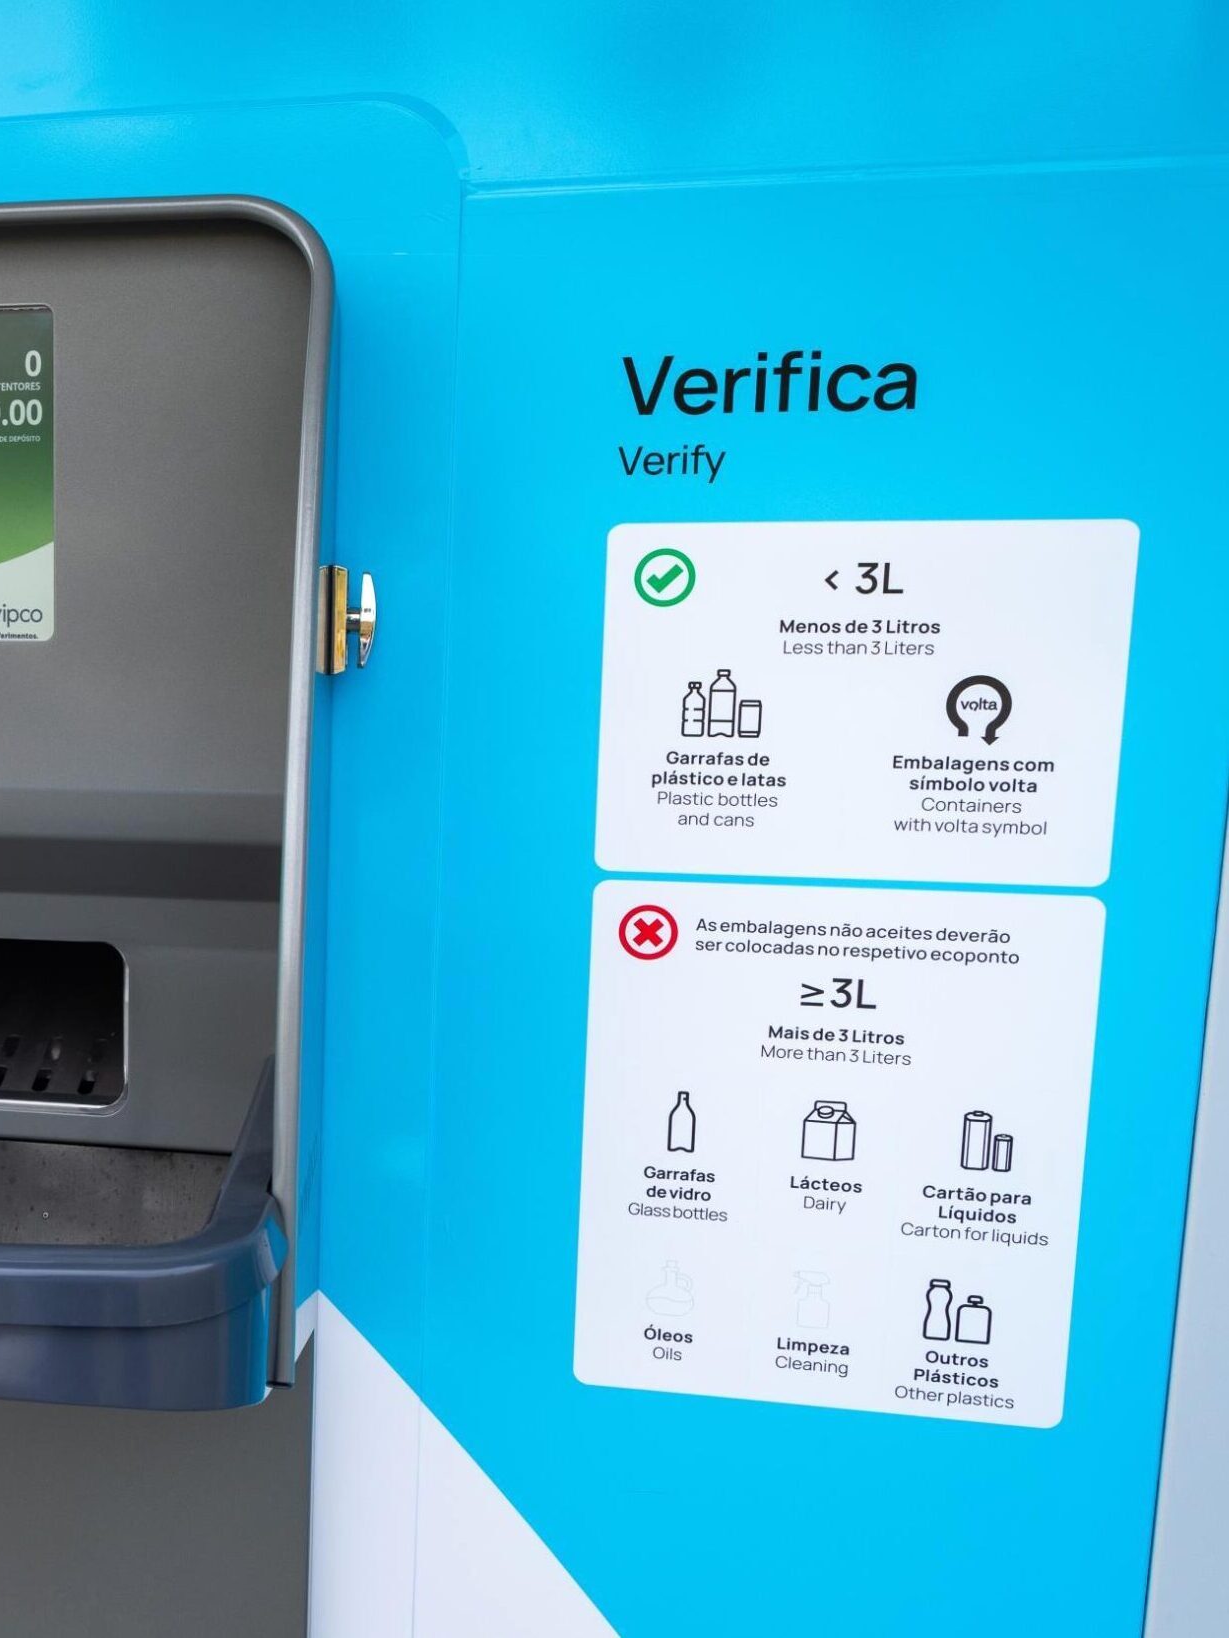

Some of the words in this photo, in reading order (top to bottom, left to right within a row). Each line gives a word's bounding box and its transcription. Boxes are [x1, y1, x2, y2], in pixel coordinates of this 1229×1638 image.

[25, 350, 42, 377] 0
[623, 350, 917, 415] Verifica
[619, 444, 726, 483] Verify
[855, 563, 903, 594] 3L
[780, 620, 841, 633] Menos
[845, 620, 868, 633] de
[872, 620, 882, 633] 3
[886, 620, 940, 634] Litros
[783, 640, 823, 654] Less
[827, 641, 867, 655] than
[871, 641, 880, 655] 3
[885, 641, 934, 655] Liters
[961, 697, 997, 711] volta
[666, 751, 744, 766] Garrafas
[748, 753, 770, 766] de
[893, 755, 1009, 775] Embalagens
[1013, 761, 1054, 772] com
[652, 770, 724, 788] plástico
[727, 776, 738, 786] e
[742, 773, 786, 787] latas
[910, 775, 985, 791] símbolo
[989, 779, 1037, 793] volta
[657, 791, 713, 805] Plastic
[718, 793, 778, 807] bottles
[922, 797, 1022, 813] Containers
[678, 813, 709, 826] and
[714, 816, 754, 827] cans
[894, 818, 931, 831] with
[935, 819, 978, 833] volta
[982, 821, 1047, 838] symbol
[696, 918, 717, 931] As
[720, 920, 826, 938] embalagens
[830, 923, 863, 937] não
[866, 926, 932, 940] aceites
[936, 928, 1010, 943] deverão
[696, 941, 722, 951] ser
[725, 940, 814, 955] colocadas
[818, 946, 839, 956] no
[843, 946, 927, 962] respetivo
[931, 950, 1019, 966] ecoponto
[769, 1025, 809, 1040] Mais
[813, 1028, 835, 1041] de
[839, 1029, 848, 1042] 3
[852, 1030, 904, 1045] Litros
[761, 1045, 803, 1059] More
[807, 1048, 846, 1061] than
[849, 1049, 859, 1062] 3
[863, 1050, 911, 1065] Liters
[644, 1166, 715, 1182] Garrafas
[646, 1186, 667, 1198] de
[669, 1187, 711, 1201] vidro
[790, 1176, 862, 1193] Lácteos
[923, 1185, 987, 1202] Cartão
[990, 1193, 1031, 1206] para
[628, 1202, 671, 1217] Glass
[673, 1206, 727, 1222] bottles
[804, 1196, 846, 1215] Dairy
[939, 1205, 1016, 1224] Líquidos
[901, 1222, 960, 1239] Carton
[964, 1227, 989, 1241] for
[992, 1229, 1048, 1247] liquids
[644, 1324, 693, 1343] Óleos
[653, 1347, 682, 1361] Oils
[777, 1337, 849, 1356] Limpeza
[775, 1356, 848, 1378] Cleaning
[926, 1351, 988, 1368] Outros
[914, 1368, 998, 1388] Plásticos
[895, 1386, 944, 1402] Other
[947, 1390, 1014, 1409] plastics
